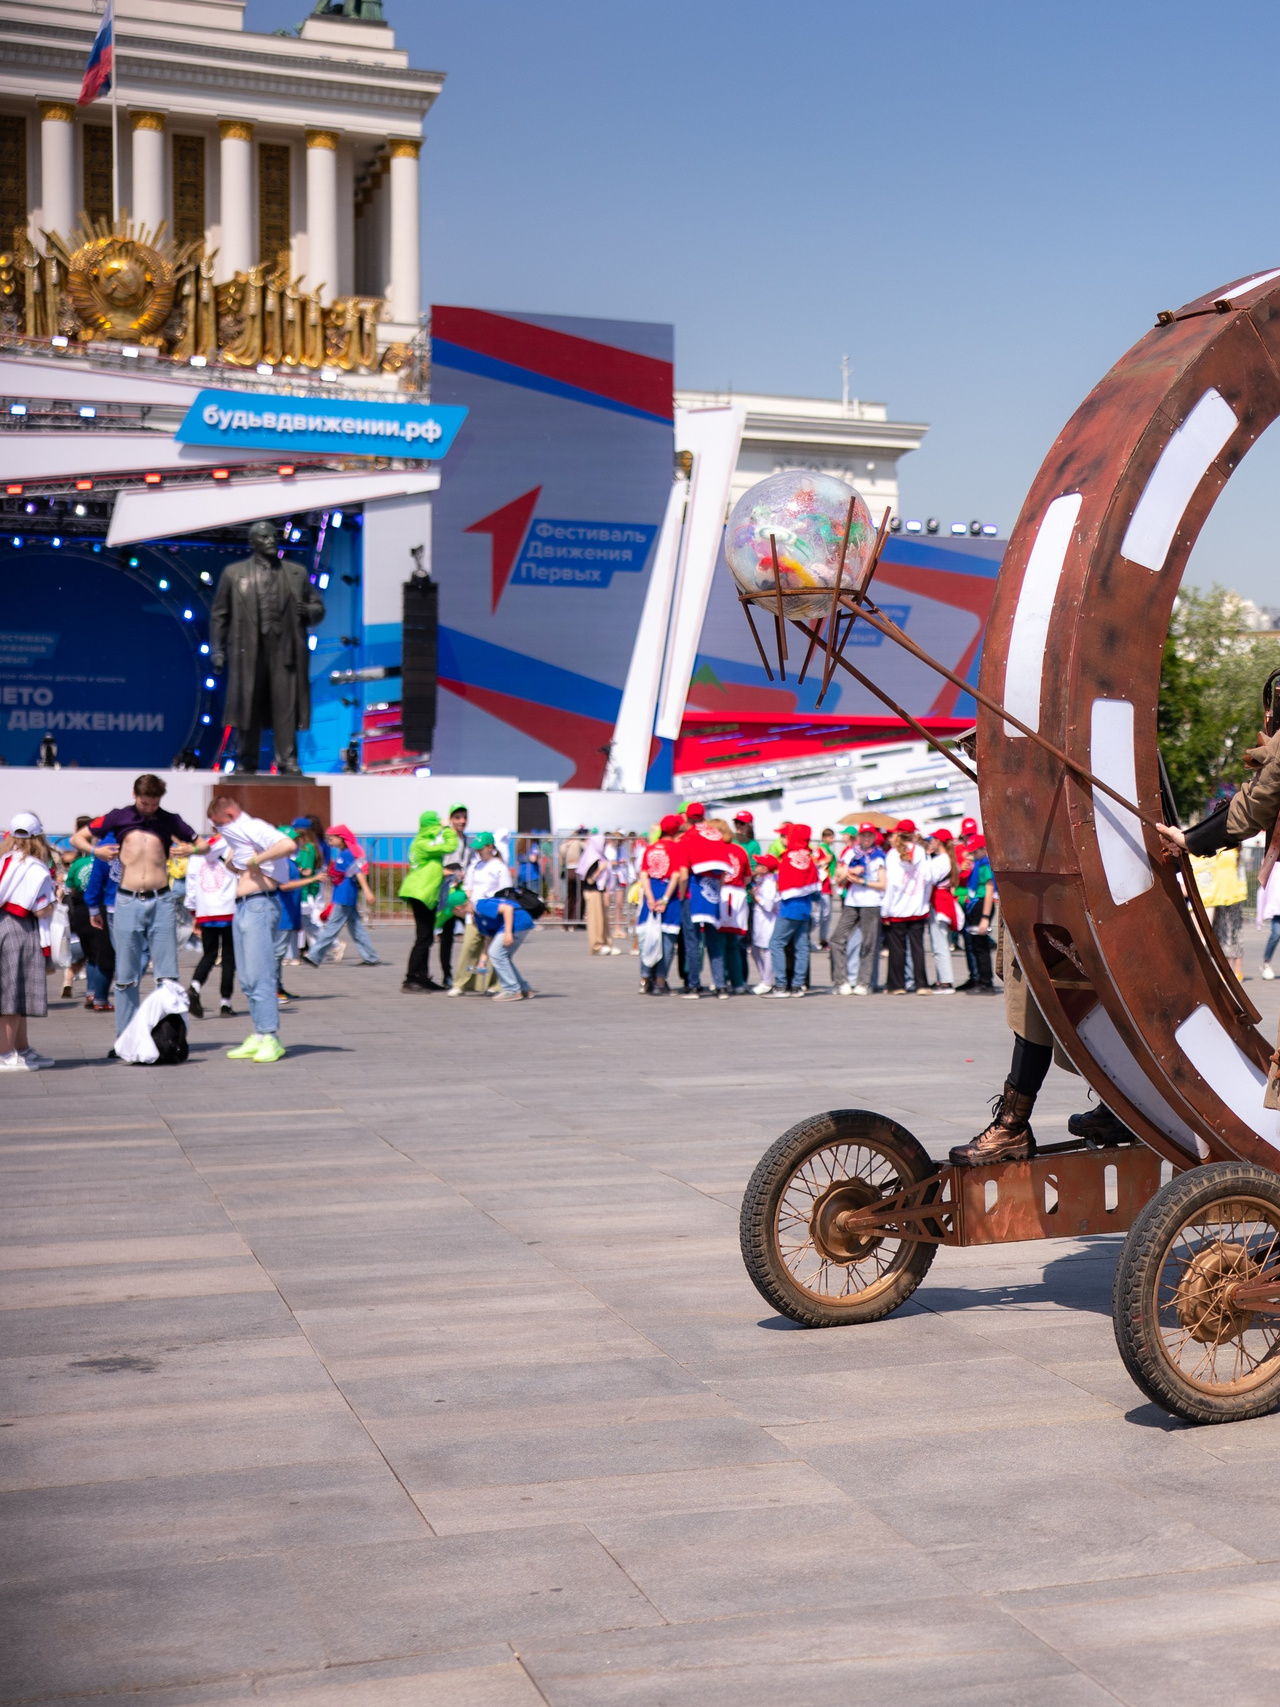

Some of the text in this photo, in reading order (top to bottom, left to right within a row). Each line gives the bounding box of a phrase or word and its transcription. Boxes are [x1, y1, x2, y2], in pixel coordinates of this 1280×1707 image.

[202, 404, 443, 443] будьвдвижении.рф
[535, 522, 647, 543] Фестиваль
[526, 541, 633, 561] Движения
[521, 562, 602, 582] Первых
[7, 709, 165, 732] ДВИЖЕНИИ
